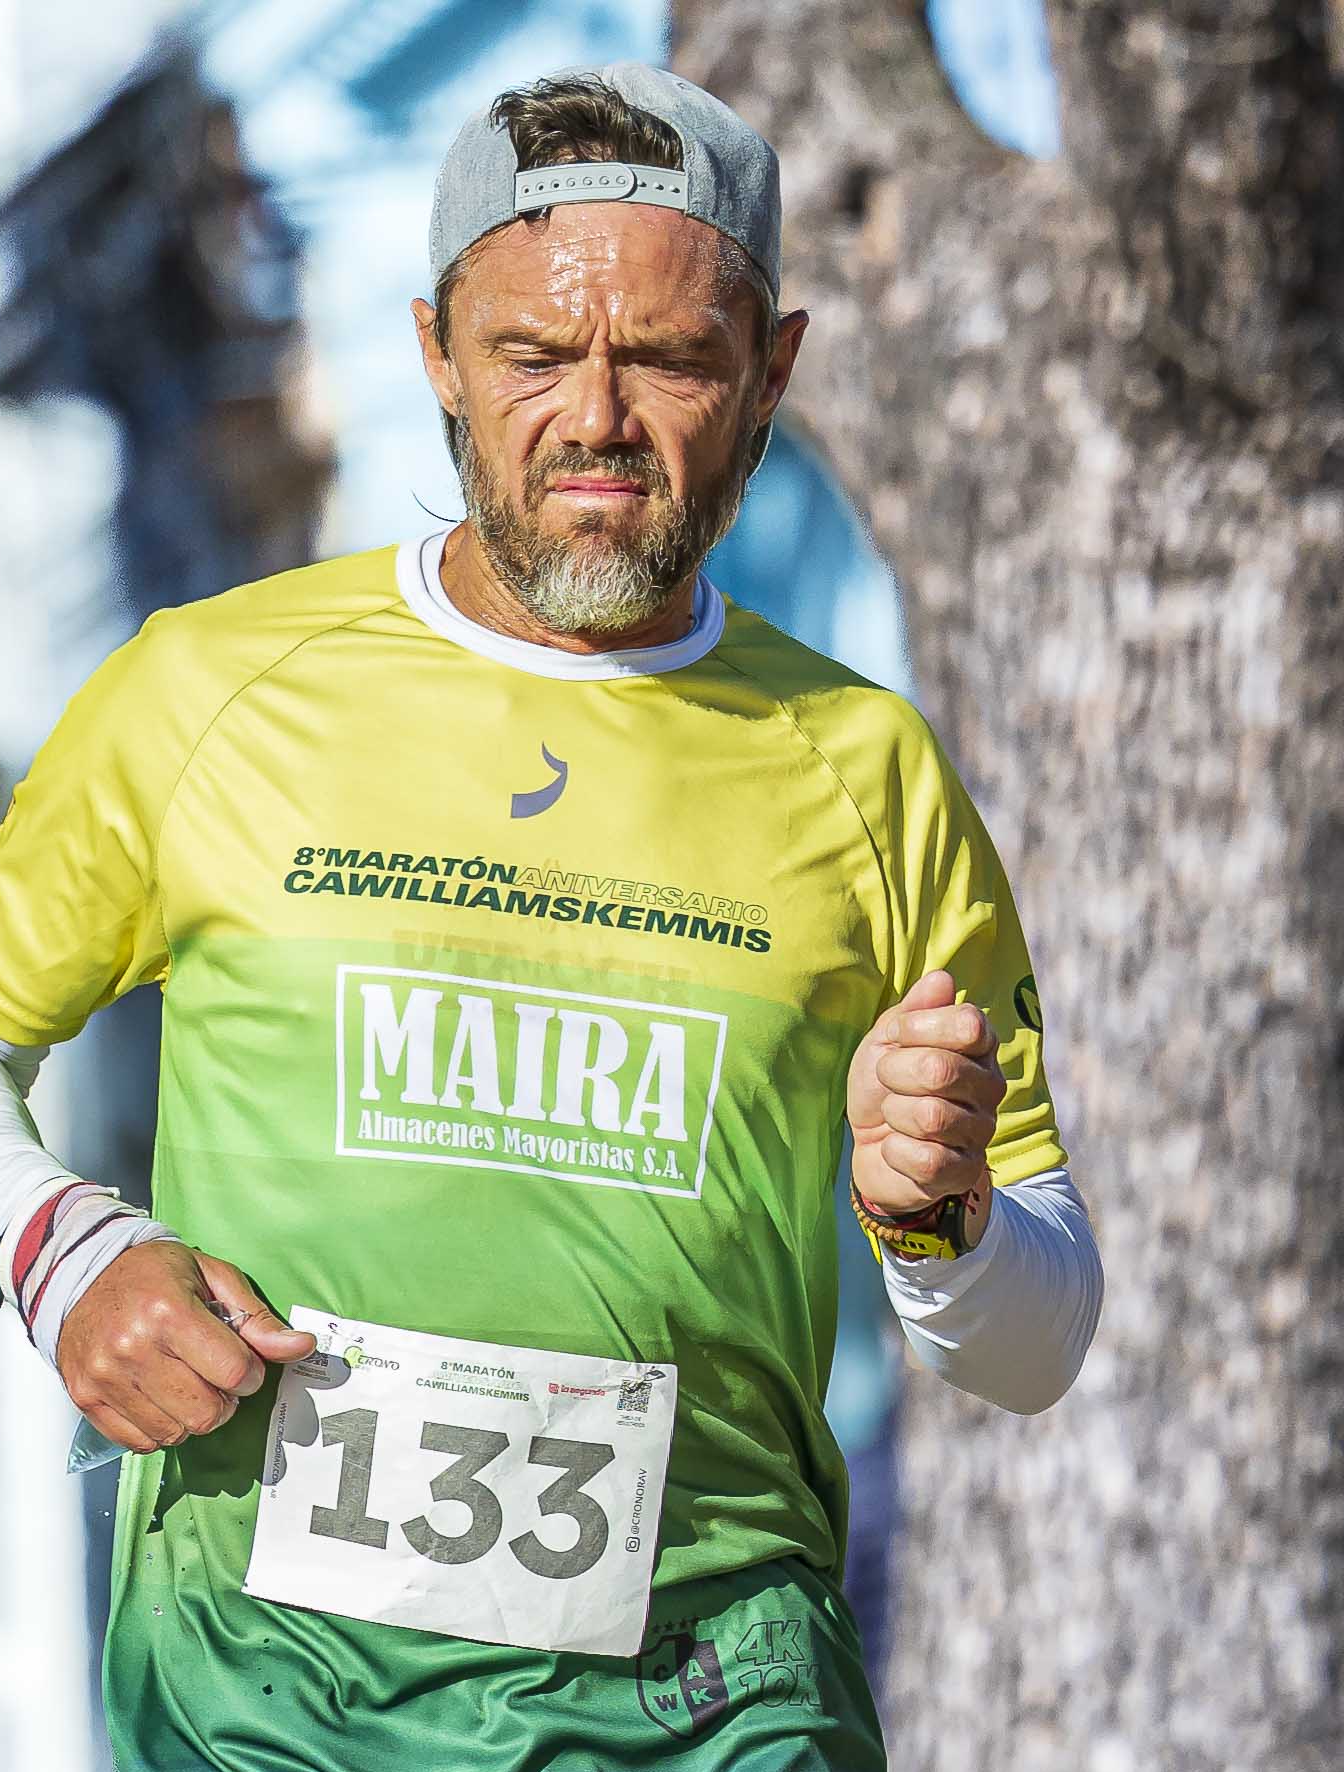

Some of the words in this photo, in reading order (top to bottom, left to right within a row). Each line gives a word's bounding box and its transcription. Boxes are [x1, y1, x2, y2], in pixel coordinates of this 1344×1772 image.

[283, 869, 772, 953] CAWILLIAMSKEMMIS
[512, 866, 768, 926] ANIVERSARIO
[359, 984, 688, 1141] MAIRA
[357, 1109, 495, 1152] Almacenes
[502, 1125, 635, 1173] Mayoristas
[642, 1147, 685, 1180] S.A.
[415, 1377, 531, 1402] CAWILLIAMSKEMMIS
[309, 1408, 616, 1580] 133
[630, 1468, 648, 1535] @CRONORAV
[734, 1619, 805, 1666] 4K
[737, 1663, 823, 1708] 10K
